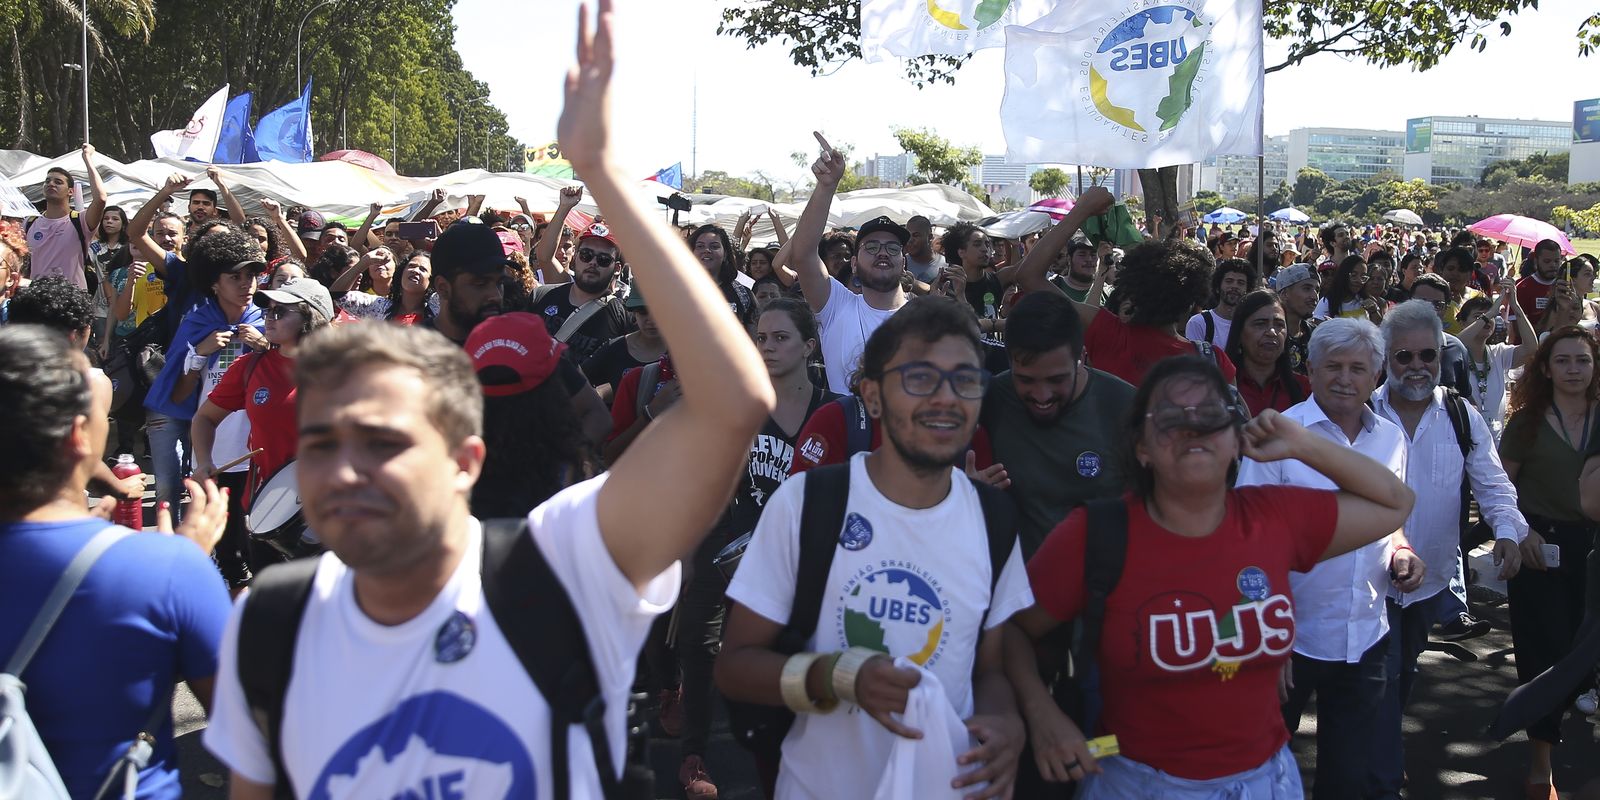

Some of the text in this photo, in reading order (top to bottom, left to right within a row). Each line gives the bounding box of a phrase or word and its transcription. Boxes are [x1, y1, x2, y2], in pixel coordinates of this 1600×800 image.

[751, 461, 789, 483] JUVEN
[842, 564, 874, 593] UNIÃO
[880, 559, 943, 593] BRASILEIRA
[942, 599, 952, 622] DOS
[869, 595, 932, 626] UBES
[1149, 593, 1296, 672] UJS
